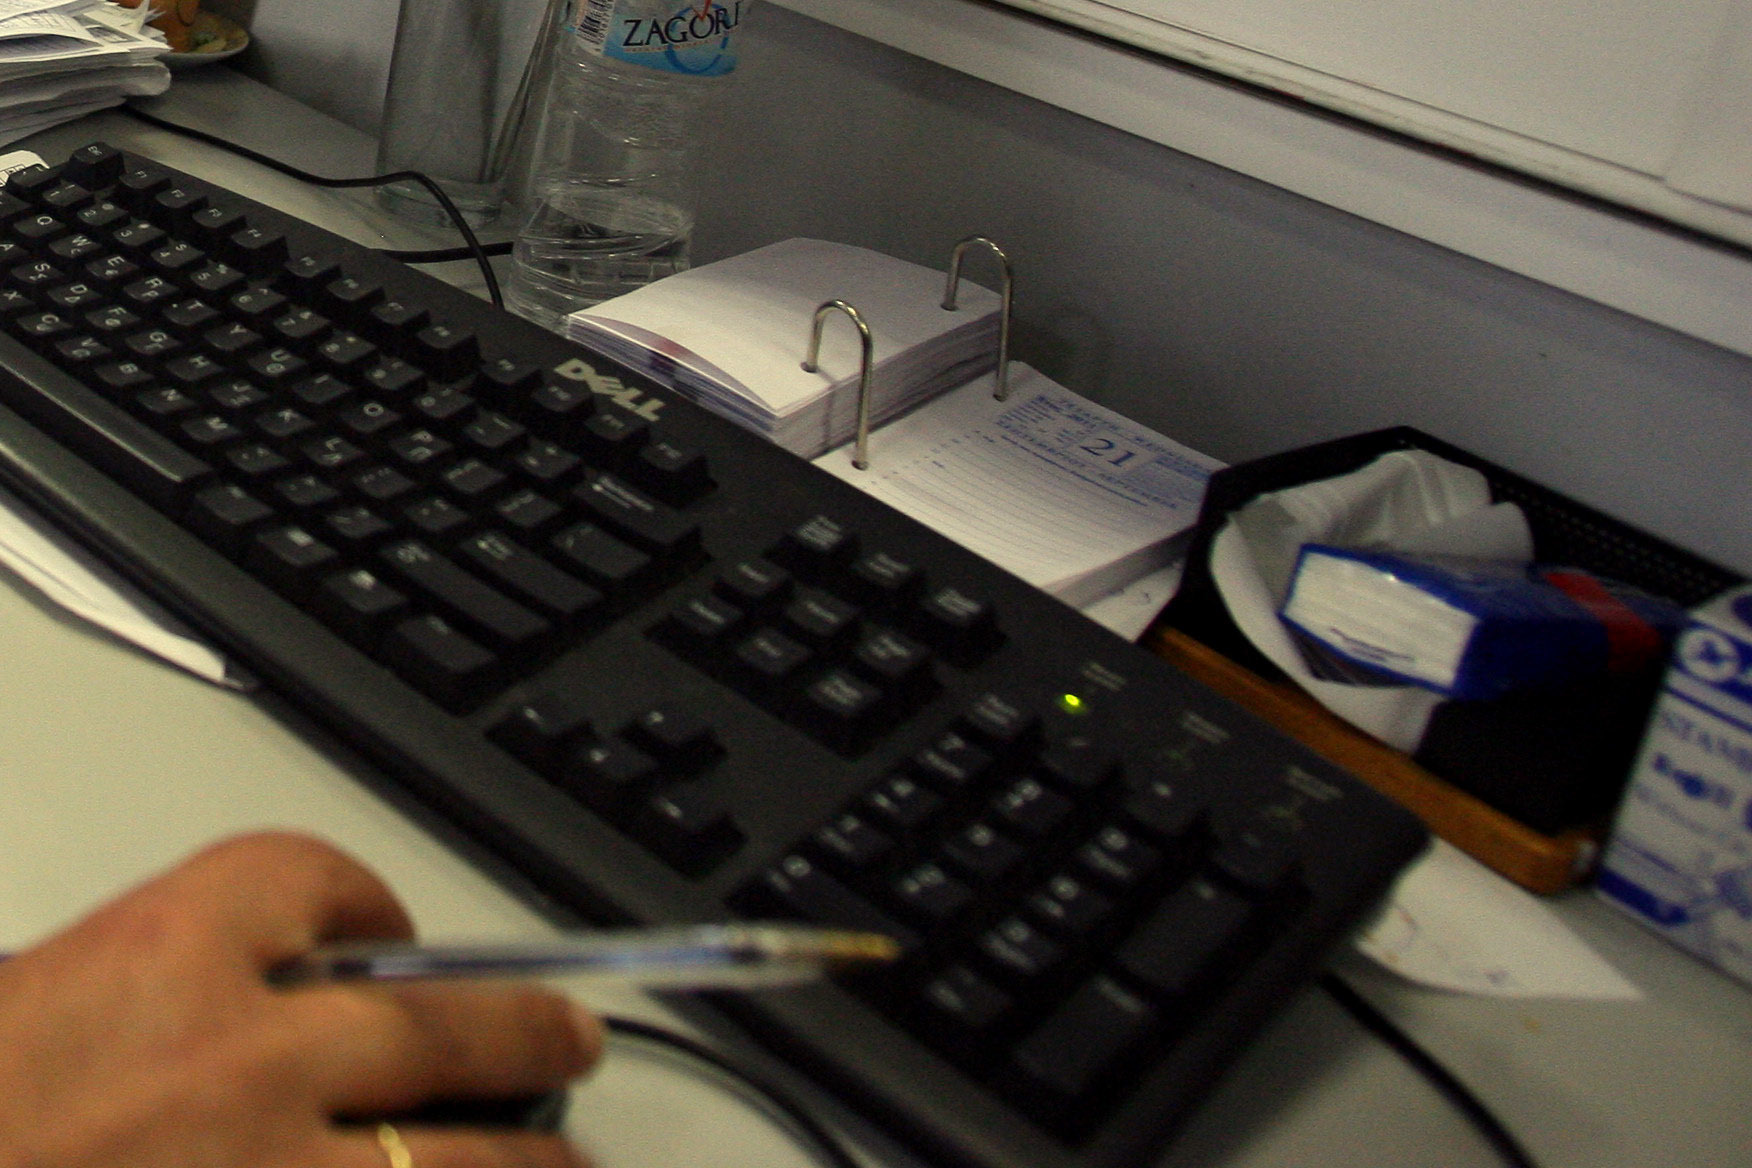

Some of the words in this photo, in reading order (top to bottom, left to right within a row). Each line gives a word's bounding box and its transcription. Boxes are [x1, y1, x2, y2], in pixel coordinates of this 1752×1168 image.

[622, 0, 744, 48] ZAGORI
[554, 358, 669, 423] DELL
[1079, 437, 1137, 468] 21
